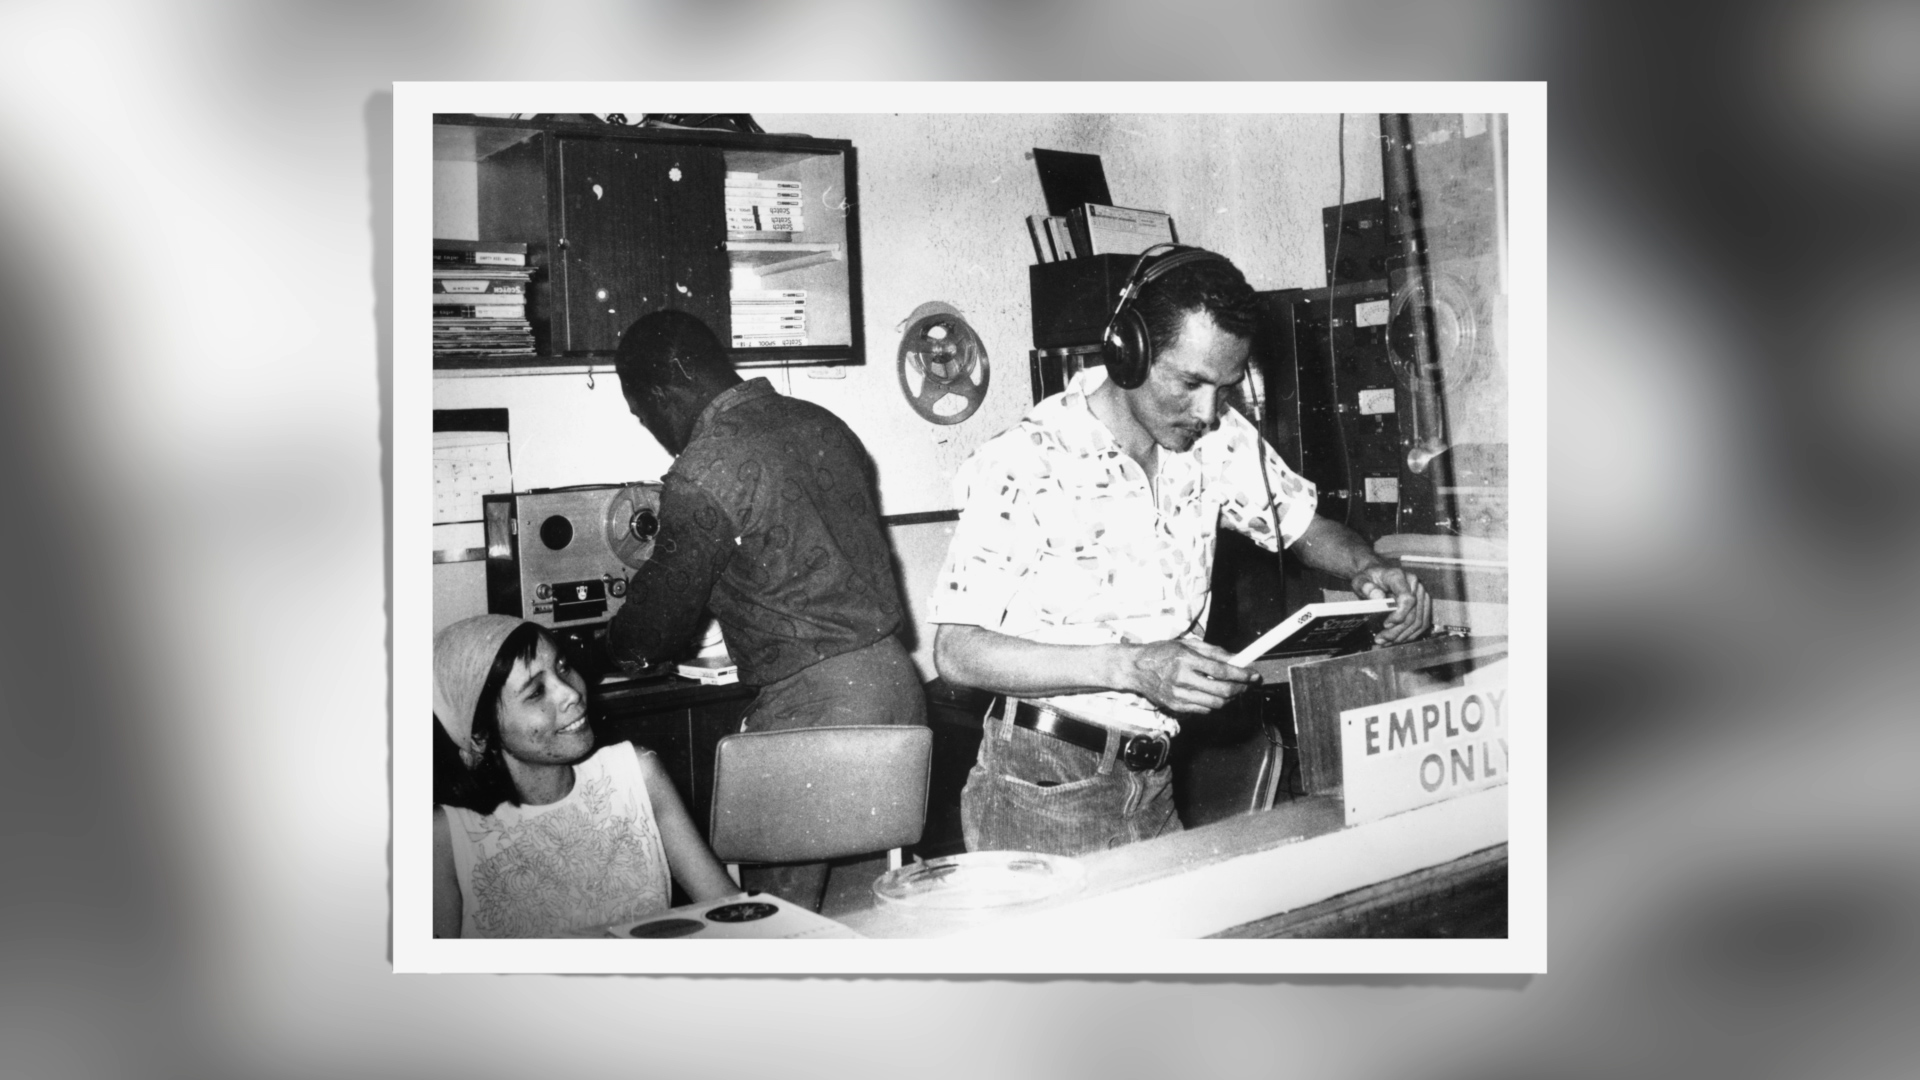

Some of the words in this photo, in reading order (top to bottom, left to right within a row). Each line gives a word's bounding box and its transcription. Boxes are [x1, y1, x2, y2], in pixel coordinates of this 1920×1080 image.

[769, 207, 791, 215] Scotch
[770, 216, 792, 224] Scotch
[772, 223, 794, 231] Scotch
[493, 285, 521, 294] SCOTCH
[781, 338, 803, 346] Scotch
[1365, 689, 1506, 756] EMPLOY
